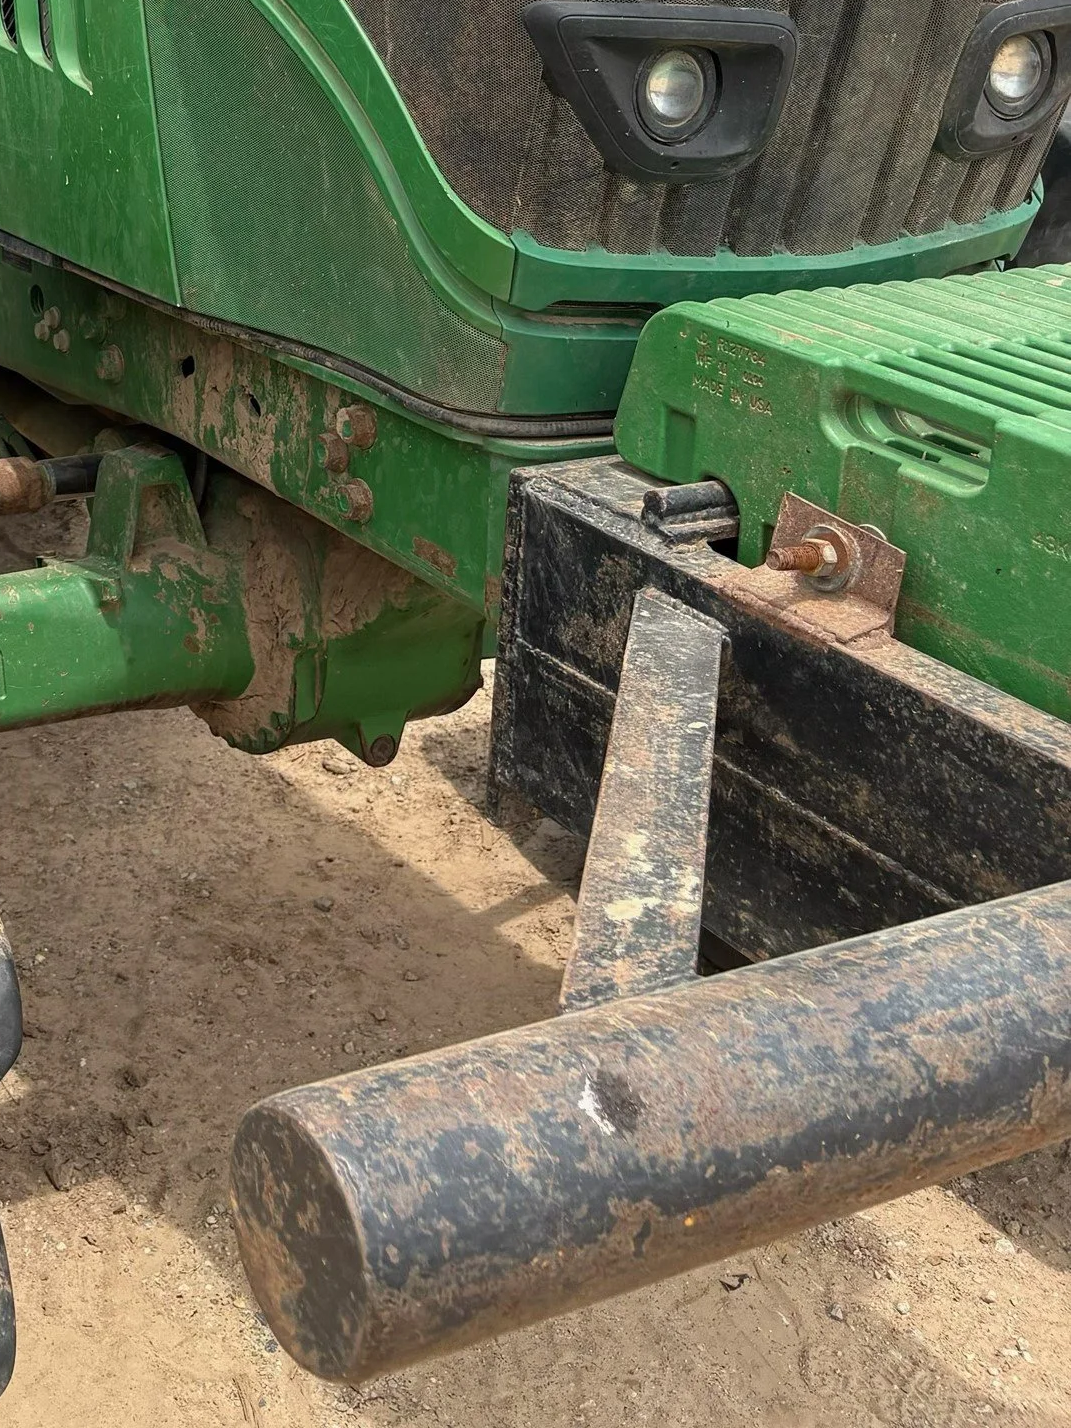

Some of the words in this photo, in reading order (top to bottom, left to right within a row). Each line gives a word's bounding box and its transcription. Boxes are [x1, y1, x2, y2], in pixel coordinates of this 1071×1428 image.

[692, 373, 724, 398] MADE
[730, 386, 743, 406] IN
[749, 394, 773, 417] USA
